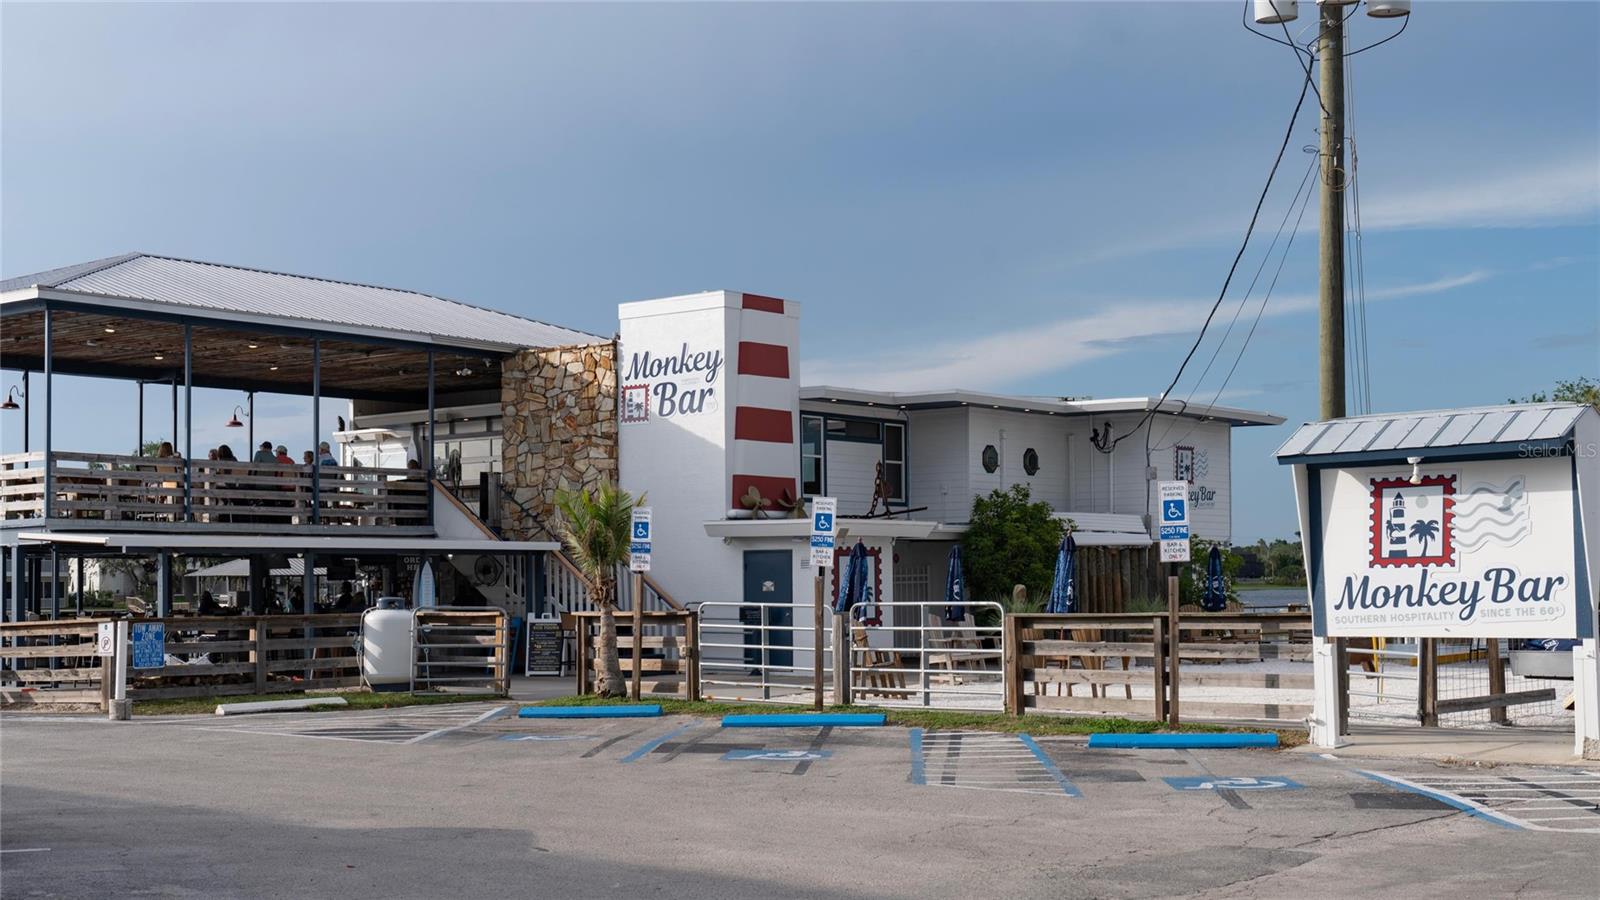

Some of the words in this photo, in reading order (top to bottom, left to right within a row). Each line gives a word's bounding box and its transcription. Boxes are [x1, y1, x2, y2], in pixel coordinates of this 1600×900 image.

[625, 343, 723, 383] Monkey
[653, 382, 713, 417] Bar
[1200, 487, 1216, 501] Bar
[1160, 527, 1176, 535] $250
[1334, 569, 1485, 621] Monkey
[1483, 568, 1564, 603] Bar
[1335, 614, 1387, 624] SOUTHERN
[1390, 612, 1455, 622] HOSPITALITY
[1480, 607, 1512, 618] SINCE
[1514, 607, 1535, 617] THE
[135, 624, 146, 633] TOW
[149, 624, 162, 632] AWAY
[142, 632, 156, 641] ZONE
